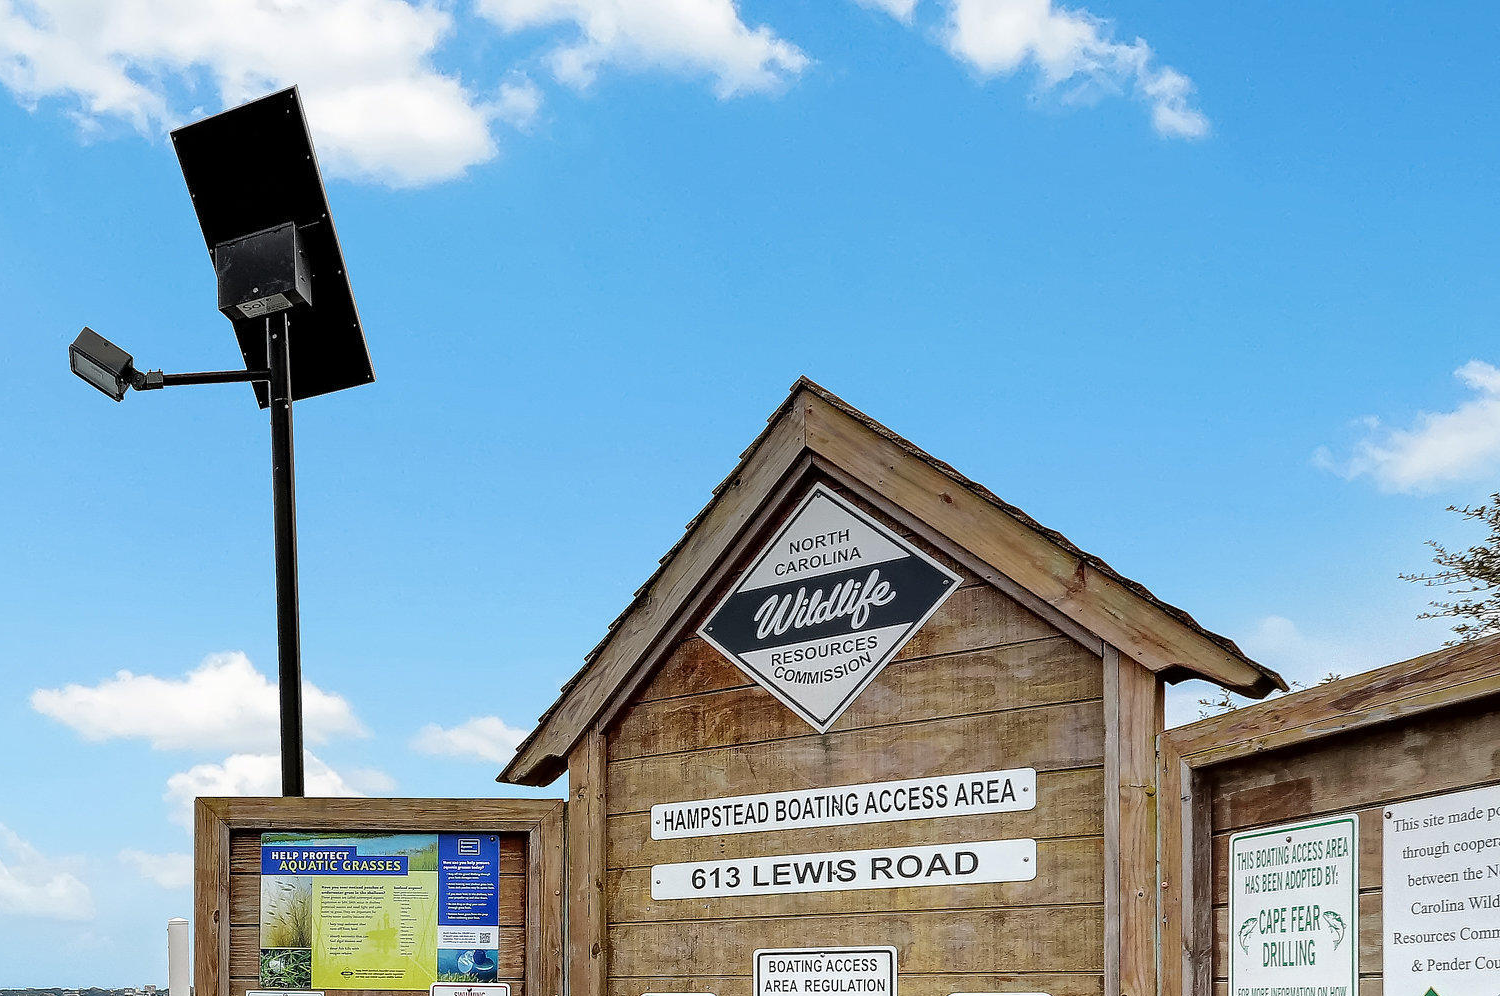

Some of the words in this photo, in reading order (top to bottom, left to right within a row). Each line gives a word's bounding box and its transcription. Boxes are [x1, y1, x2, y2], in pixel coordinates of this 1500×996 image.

[789, 529, 850, 554] NORTH
[774, 546, 861, 576] CAROLINA
[754, 569, 896, 640] Wildlife
[771, 636, 878, 666] RESOURCES
[774, 652, 871, 684] COMMISSION
[664, 802, 768, 832] HAMPSTEAD
[775, 793, 859, 822] BOATING
[866, 785, 947, 814] ACCESS
[955, 779, 1016, 806] AREA
[1393, 818, 1419, 832] This
[1423, 814, 1444, 828] site
[1448, 807, 1483, 824] made
[271, 851, 299, 860] HELP
[303, 851, 349, 860] PROTECT
[1237, 852, 1255, 871] THIS
[1256, 847, 1289, 868] BOATING
[1292, 842, 1323, 864] ACCESS
[1326, 837, 1348, 858] AREA
[1403, 841, 1449, 859] through
[279, 860, 338, 872] AQUATIC
[343, 860, 401, 871] GRASSES
[691, 866, 740, 889] 613
[753, 859, 856, 888] LEWIS
[871, 851, 979, 880] ROAD
[1408, 872, 1458, 887] between
[1463, 868, 1483, 880] the
[1245, 877, 1259, 895] HAS
[1262, 874, 1282, 893] BEEN
[1285, 869, 1322, 891] ADOPTED
[1259, 908, 1287, 935] CAPE
[1291, 905, 1321, 932] FEAR
[1411, 900, 1464, 915] Carolina
[1394, 931, 1456, 944] Resources
[769, 960, 821, 973] BOATING
[826, 959, 877, 972] ACCESS
[1263, 940, 1316, 967] DRILLING
[1412, 959, 1423, 972] &
[1427, 958, 1471, 971] Pender
[765, 980, 798, 992] AREA
[805, 979, 885, 992] REGULATION
